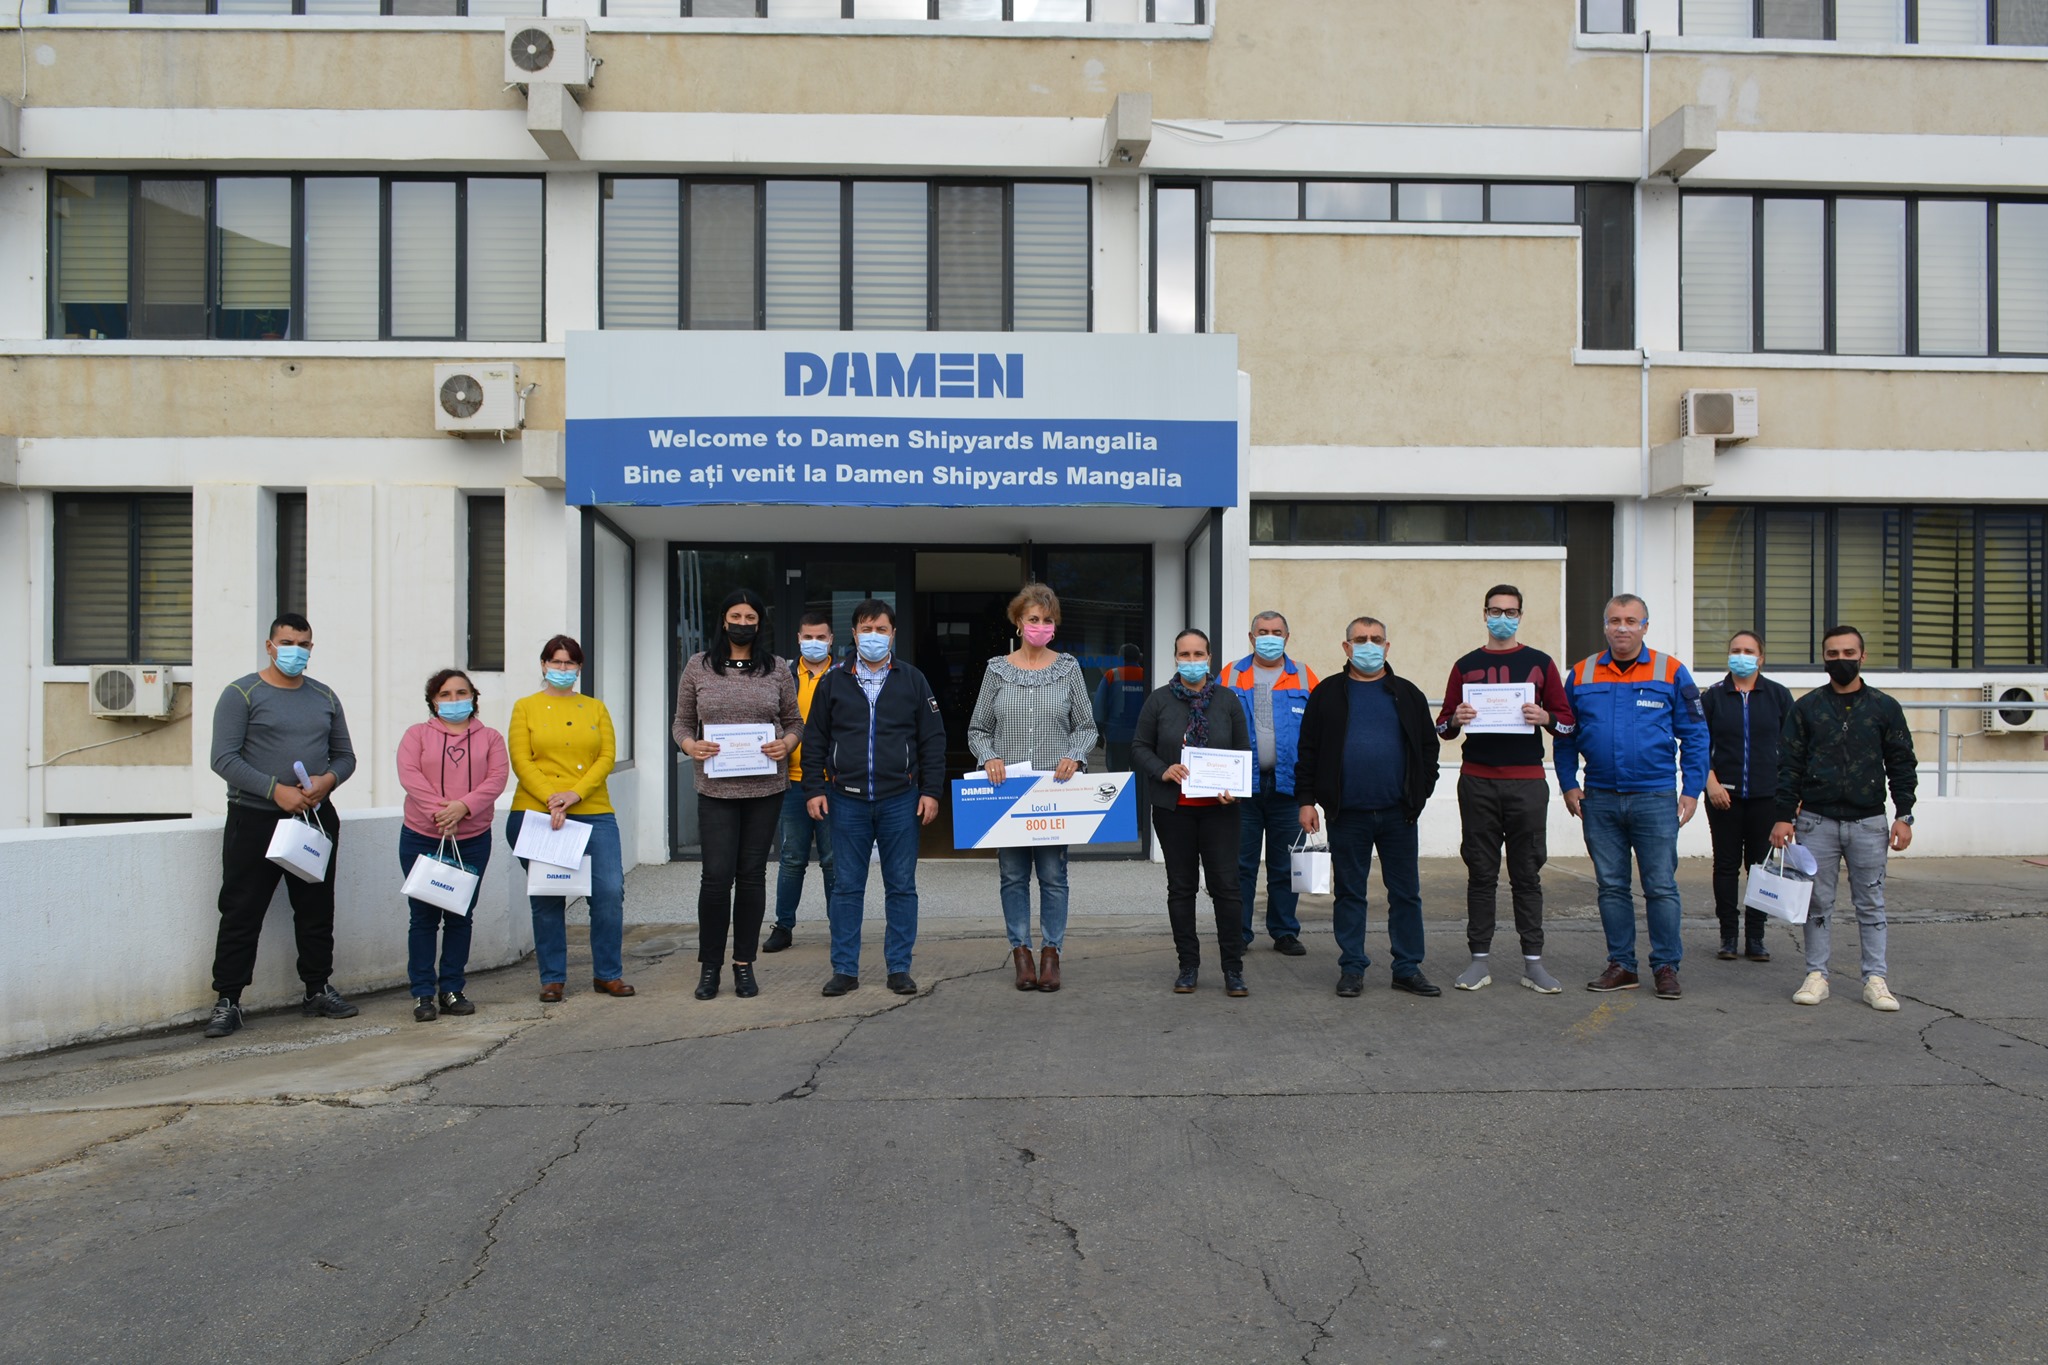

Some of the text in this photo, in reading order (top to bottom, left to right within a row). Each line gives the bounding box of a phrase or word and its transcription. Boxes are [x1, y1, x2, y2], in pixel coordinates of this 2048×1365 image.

[784, 351, 1024, 398] DAMEN
[648, 429, 1158, 454] Welcome to Damen Shipyards Mangalia
[623, 465, 681, 484] Bine
[731, 464, 796, 483] venit
[804, 464, 827, 483] la
[836, 464, 924, 484] Damen
[932, 466, 1058, 490] Shipyards
[1066, 467, 1182, 490] Mangalia
[1291, 706, 1305, 715] DAM
[1636, 699, 1665, 709] DAMEN
[961, 787, 994, 796] DAMEN
[1031, 803, 1051, 812] Locul
[1026, 818, 1065, 831] 800 LEI
[303, 844, 321, 858] DAMEN
[430, 879, 455, 893] DAMEN
